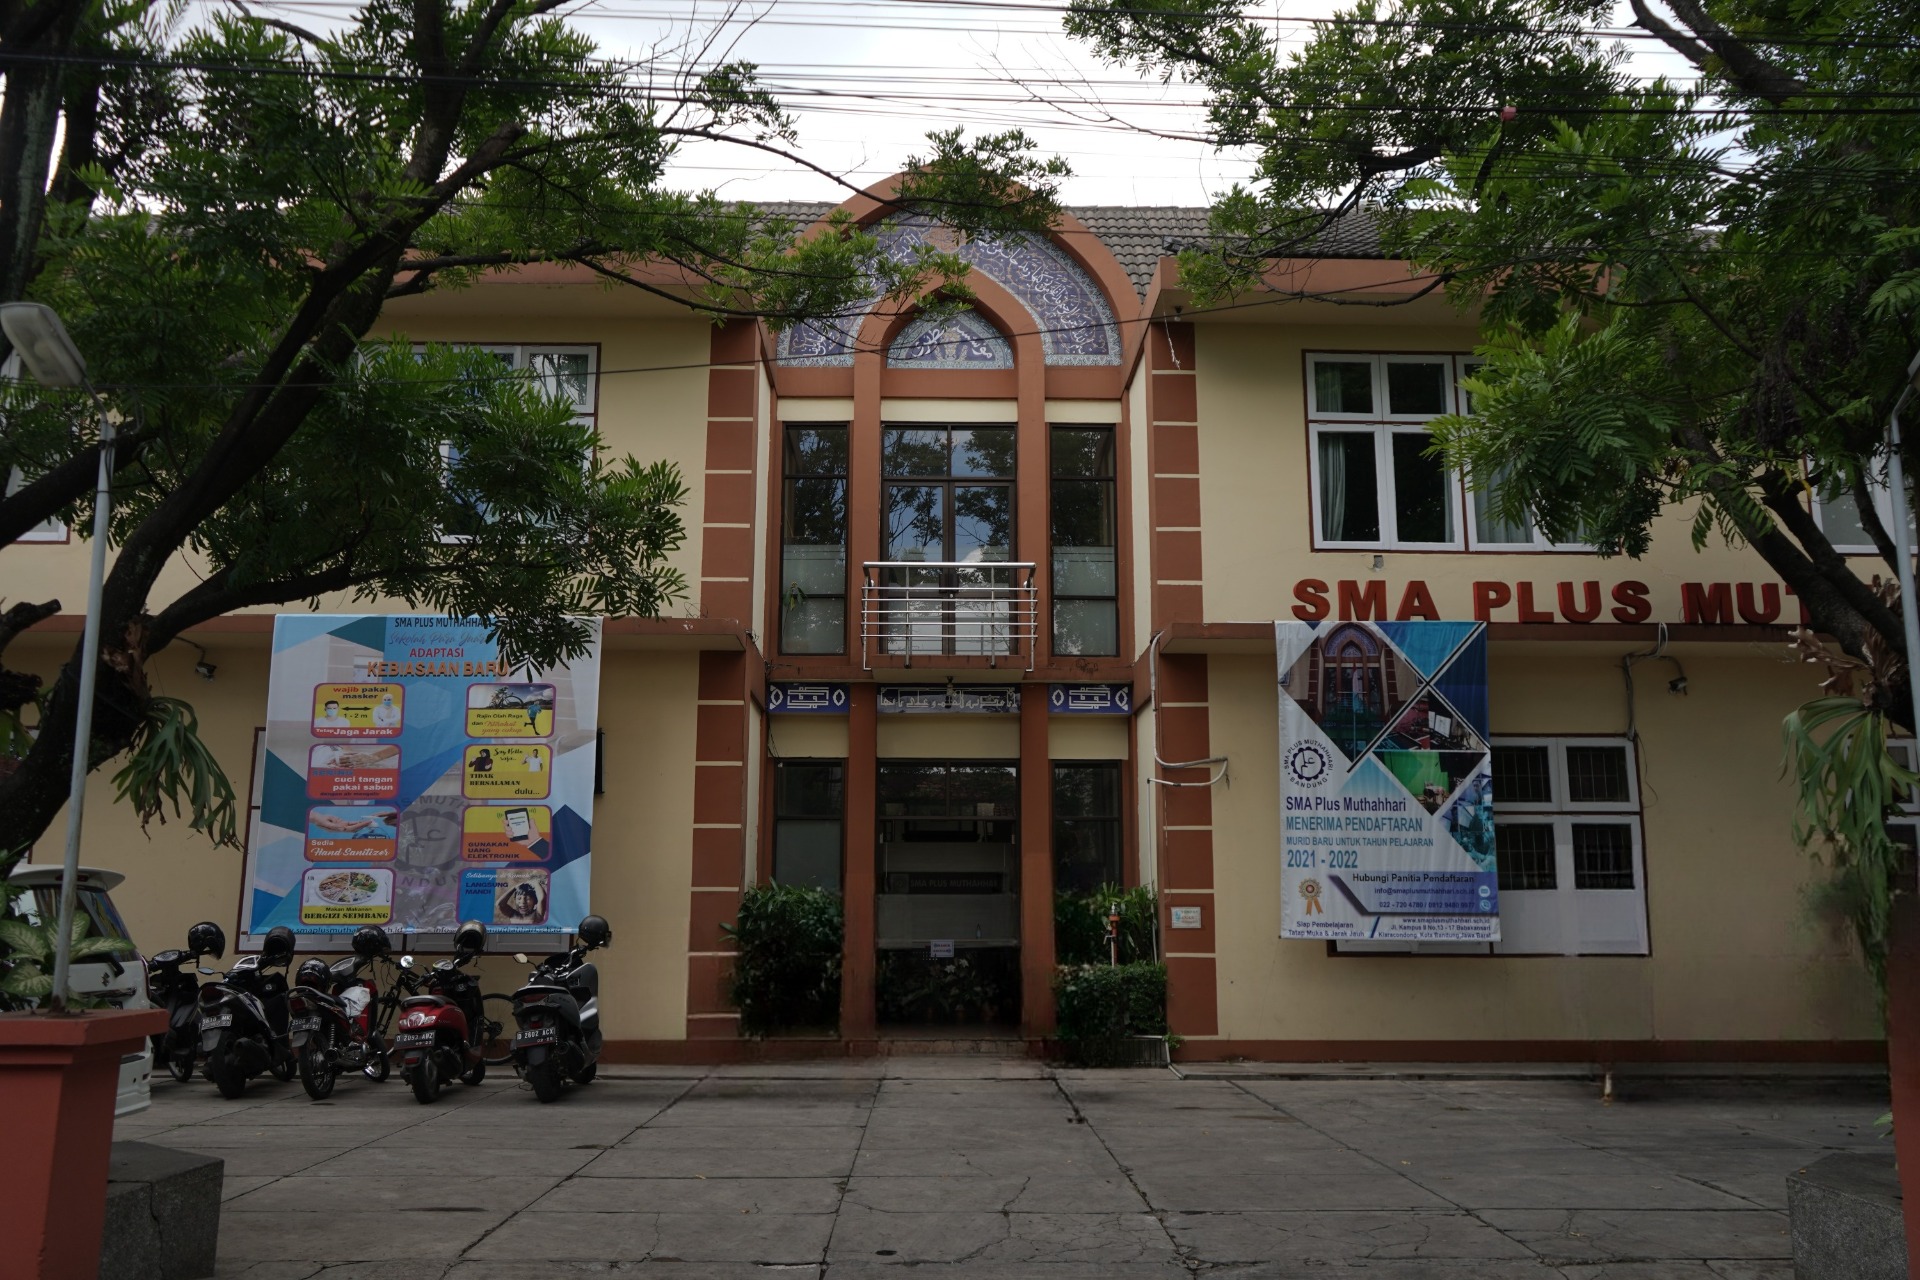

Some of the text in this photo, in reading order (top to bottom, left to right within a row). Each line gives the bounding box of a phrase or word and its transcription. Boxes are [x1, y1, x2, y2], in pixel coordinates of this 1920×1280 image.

[1291, 578, 1441, 621] SMA
[1473, 580, 1653, 624] PLUS
[395, 618, 412, 628] SMA
[414, 618, 434, 628] PLUS
[410, 648, 464, 658] ADAPTASI
[367, 661, 508, 677] KEBIASAAN BARU
[333, 686, 388, 694] wajib pakai
[333, 728, 359, 736] Jaga
[363, 728, 393, 736] Jarak
[358, 776, 394, 784] tangan
[1289, 777, 1329, 789] BANDUNG
[332, 784, 360, 792] pakai
[1286, 796, 1406, 811] SMA Plus Muthahhari
[1286, 816, 1423, 832] MENERIMA PENDAFTARAN
[1286, 836, 1434, 848] MURID BARU UNTUK TAHUN PELAJARAN
[310, 847, 391, 857] Hand Sanitizer
[1287, 849, 1316, 868] 2021
[1329, 850, 1358, 868] 2022
[929, 879, 948, 888] PLUS
[1352, 873, 1475, 884] Hubungi Panitia Pendaftaran
[304, 911, 389, 919] BERGIZI SEIMBANG
[1296, 921, 1354, 930] Siap Pembelajaran
